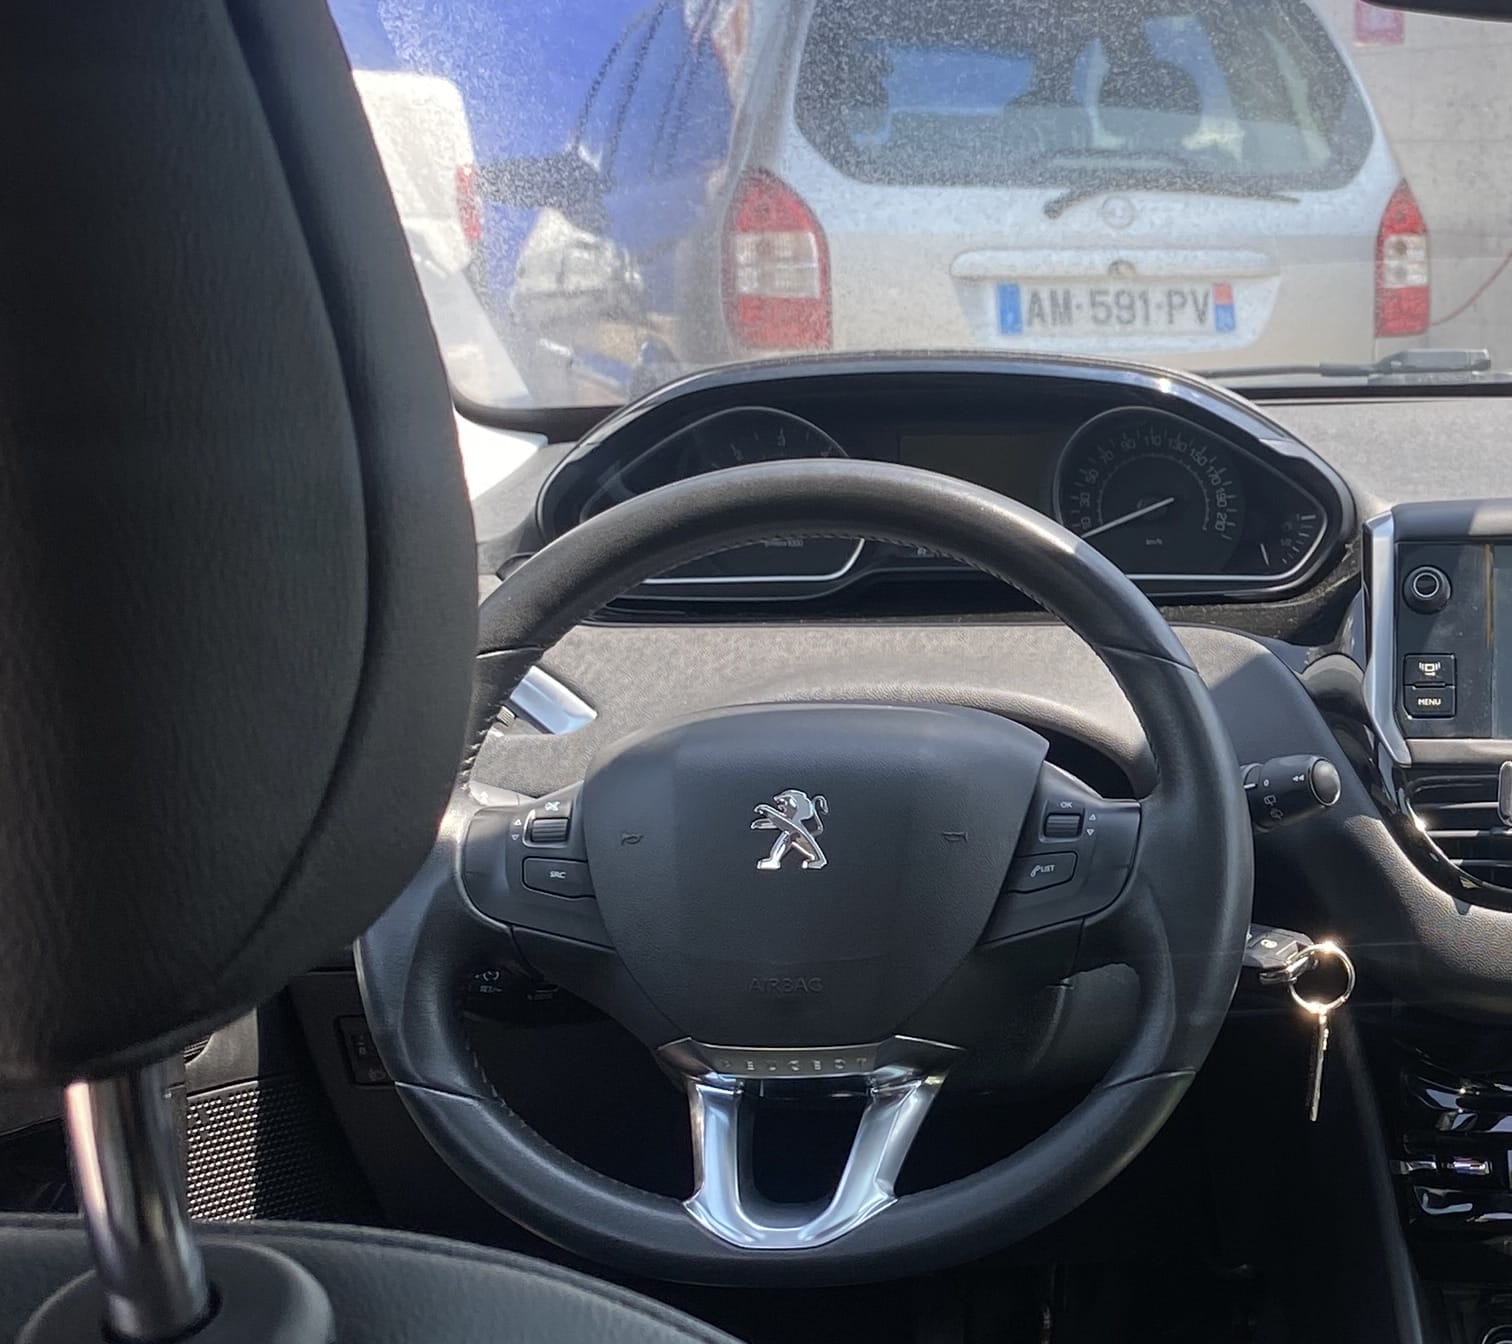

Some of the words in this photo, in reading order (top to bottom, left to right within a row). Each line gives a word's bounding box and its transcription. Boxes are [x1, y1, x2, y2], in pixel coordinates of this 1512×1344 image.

[1417, 698, 1441, 707] MENU
[1060, 801, 1073, 809] OK
[549, 870, 567, 879] SRC
[749, 976, 824, 993] AIRBAG
